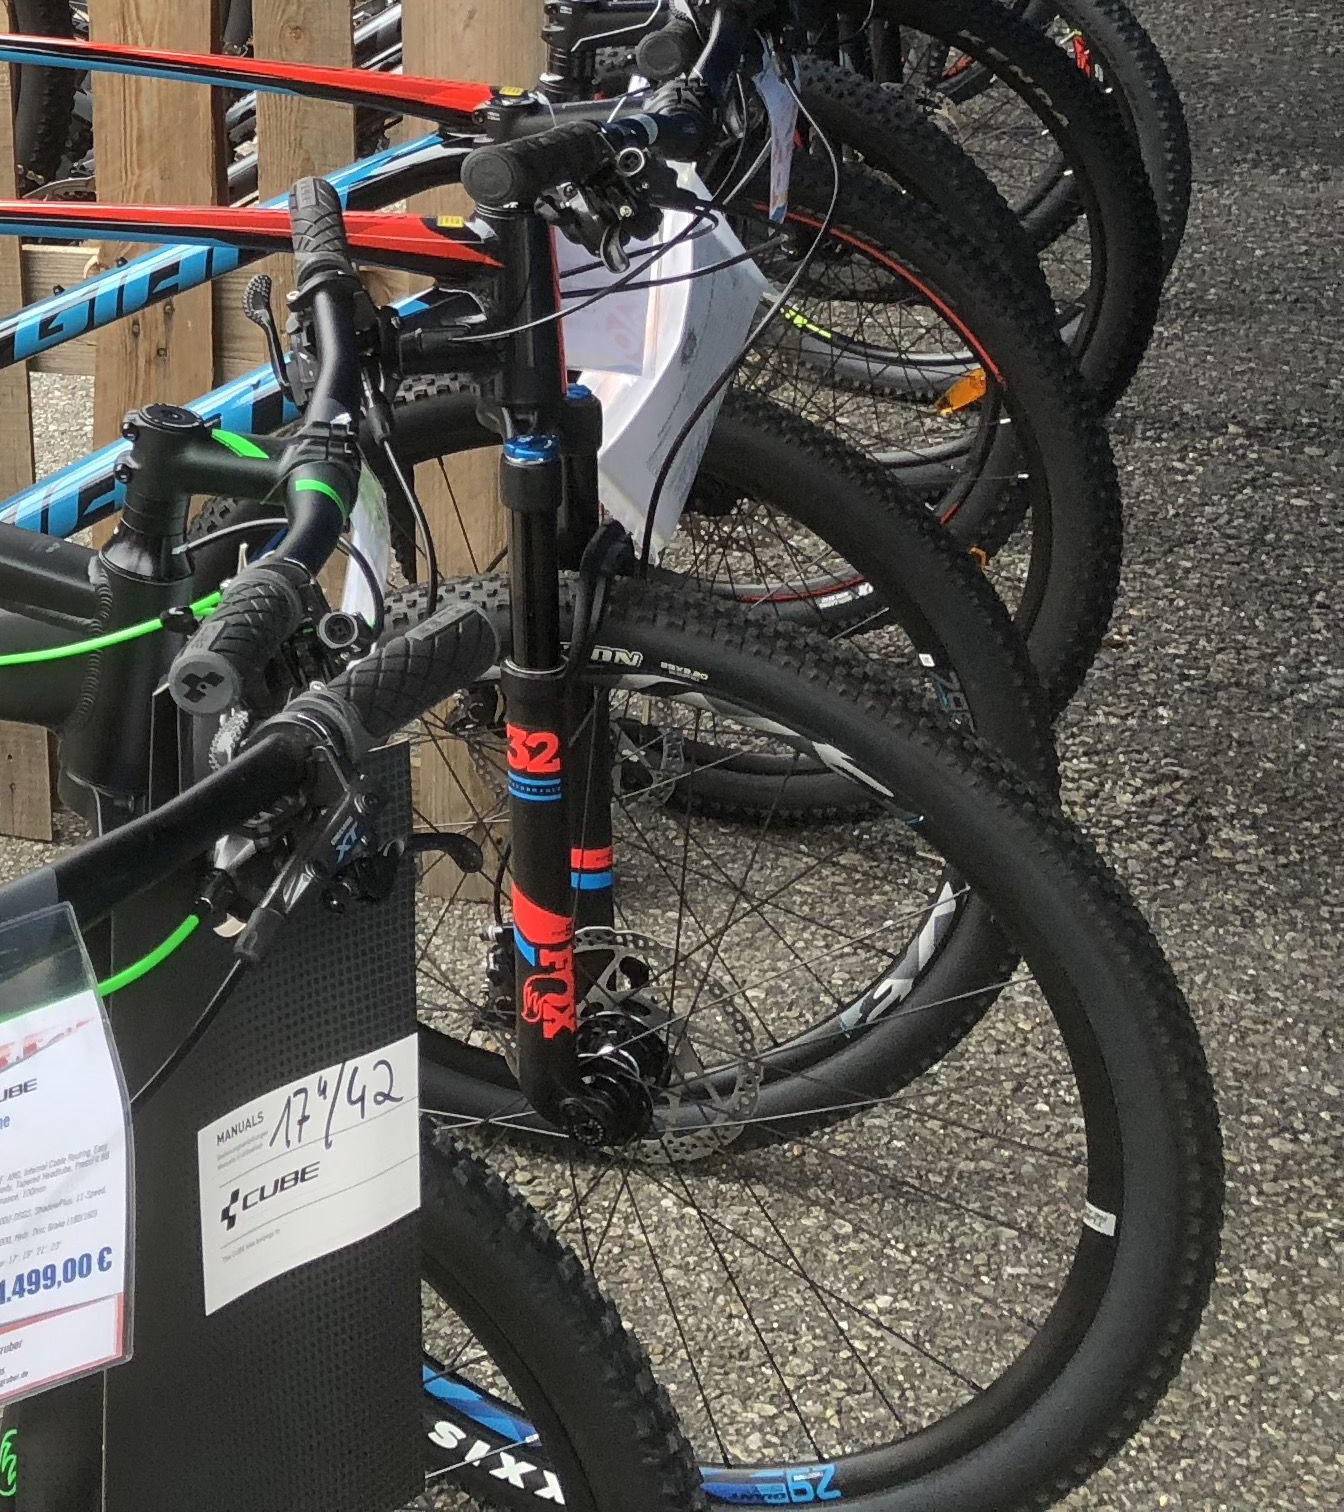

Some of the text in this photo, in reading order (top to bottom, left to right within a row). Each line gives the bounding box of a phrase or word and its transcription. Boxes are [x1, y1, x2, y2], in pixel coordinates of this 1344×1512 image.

[14, 241, 242, 361] GIA
[590, 646, 639, 668] ON
[506, 722, 561, 773] 32
[520, 947, 577, 1040] FOX
[216, 1110, 265, 1146] MANUALS
[242, 1161, 321, 1211] CUBE
[97, 1246, 113, 1272] €
